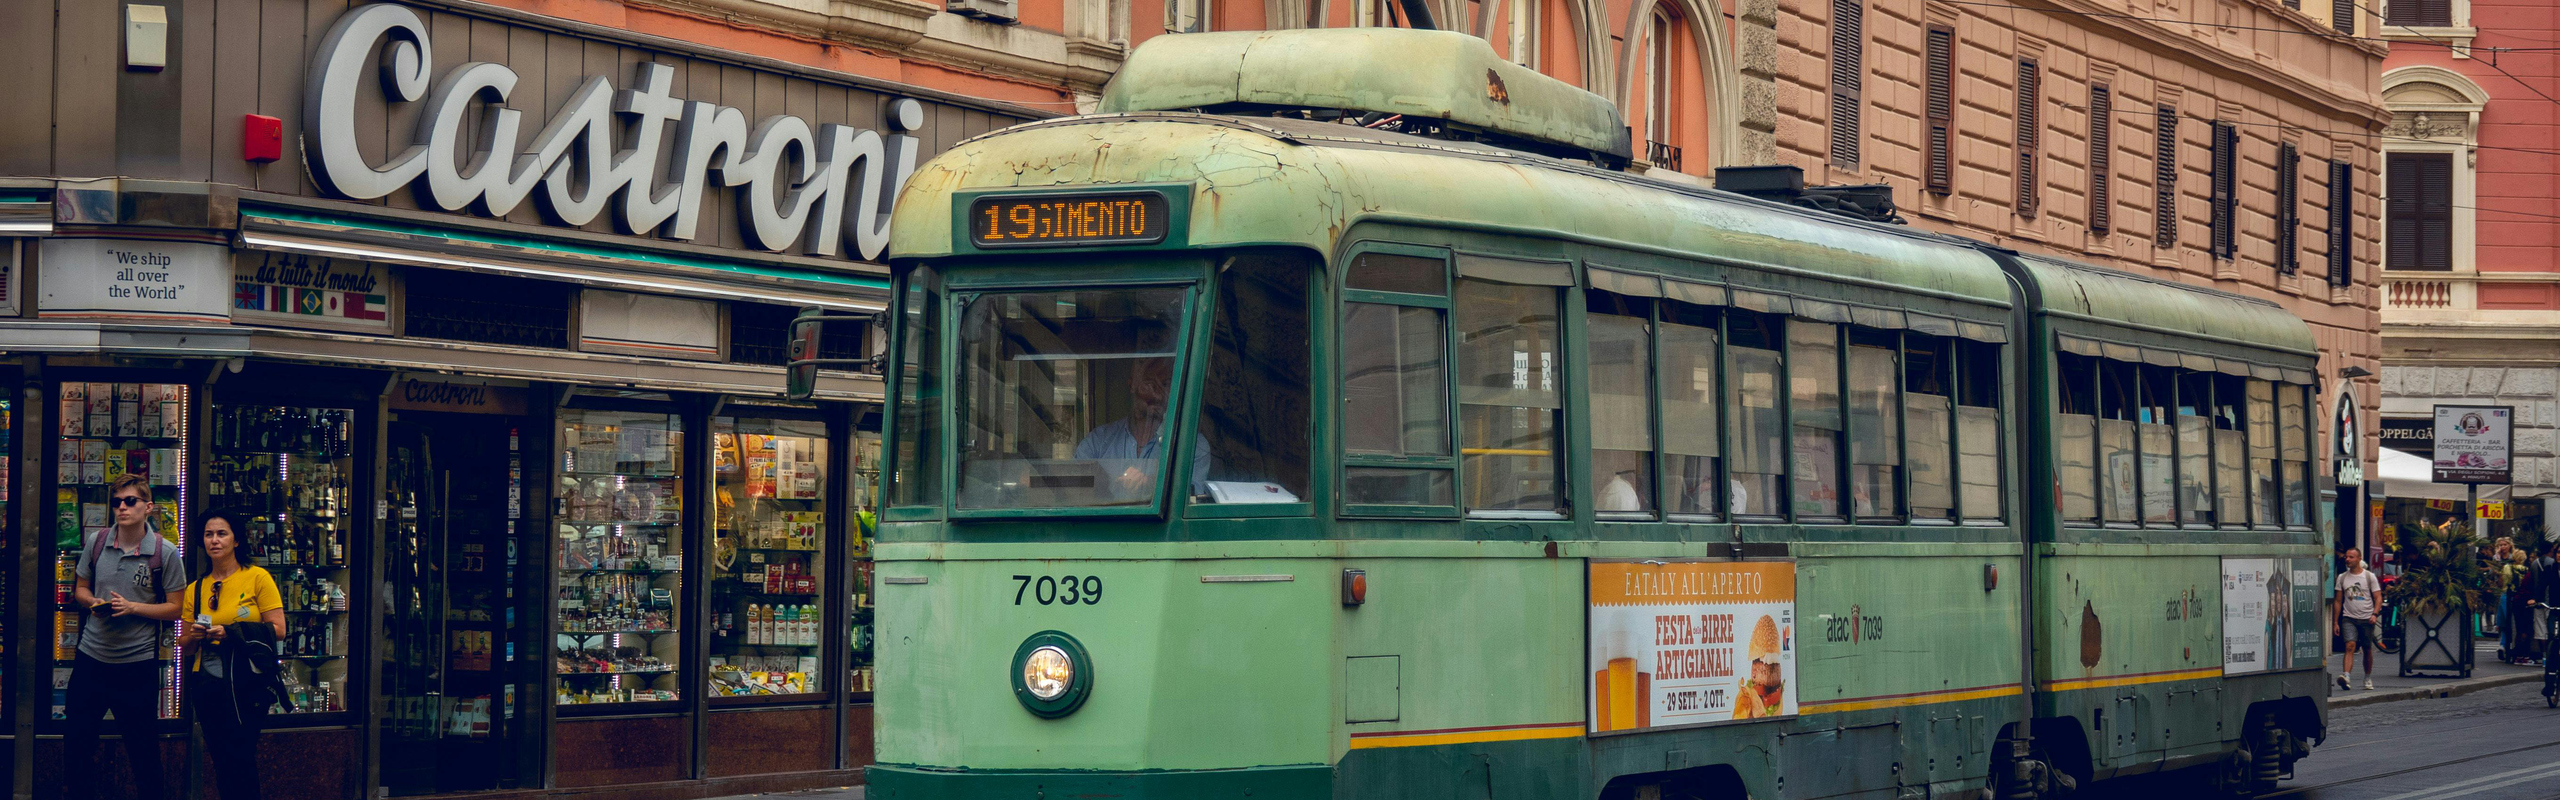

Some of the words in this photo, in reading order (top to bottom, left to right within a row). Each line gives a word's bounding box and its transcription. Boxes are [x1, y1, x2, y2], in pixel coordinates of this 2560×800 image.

[303, 3, 924, 262] Castroni
[984, 205, 1036, 239] 19
[141, 253, 171, 267] ship
[277, 256, 312, 288] tutto
[313, 257, 326, 290] il
[328, 262, 377, 293] mondo
[116, 268, 133, 281] all
[138, 271, 169, 282] over
[108, 285, 130, 298] the
[404, 378, 487, 407] Castroni
[2477, 504, 2502, 518] 1.00
[1012, 575, 1103, 606] 7039
[1625, 572, 1677, 596] EATALY
[1681, 571, 1762, 596] ALL'APERTO
[2166, 596, 2181, 621] atac
[1655, 614, 1695, 646] FESTA
[1701, 613, 1734, 644] BIRRE
[1826, 612, 1850, 642] atac
[1862, 615, 1883, 641] 7039
[1655, 648, 1734, 681] ARTIGIANALI
[1667, 691, 1677, 711] 29
[1678, 690, 1698, 710] SETT.
[1703, 690, 1709, 708] 2
[1710, 689, 1726, 708] OTT.
